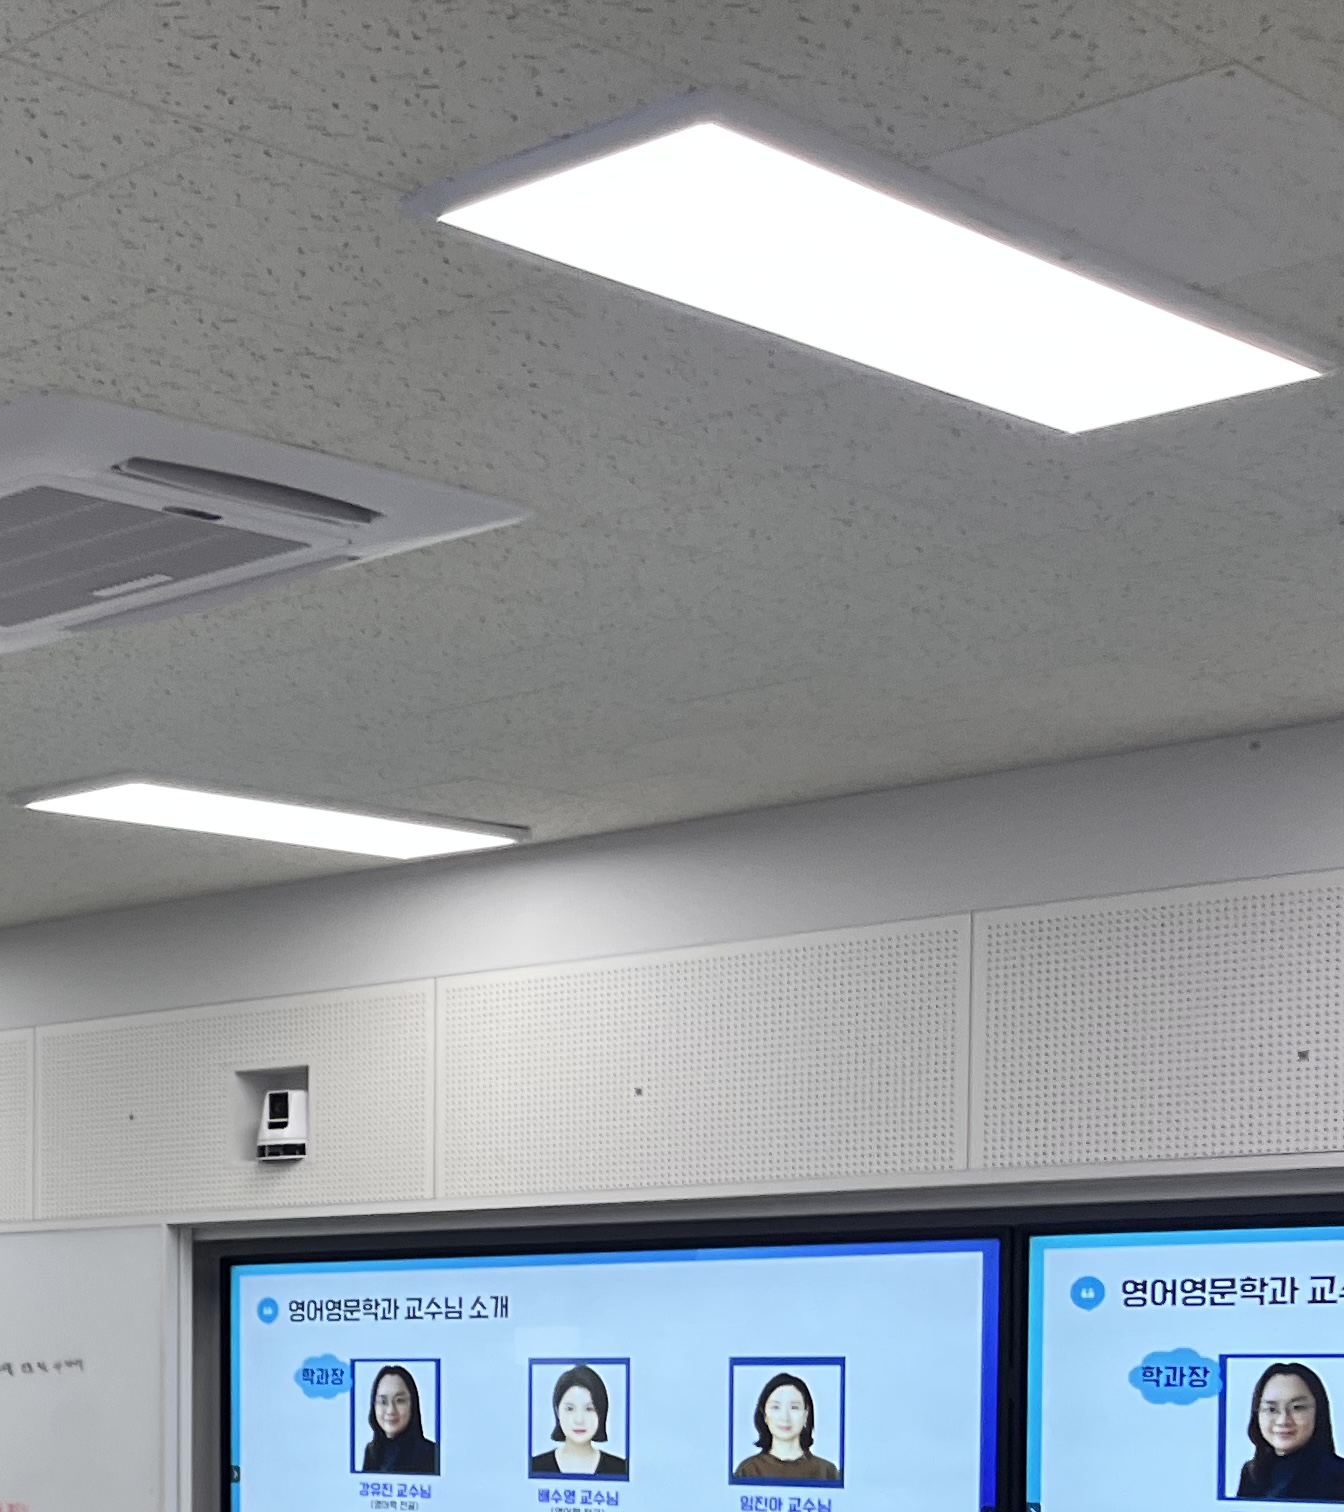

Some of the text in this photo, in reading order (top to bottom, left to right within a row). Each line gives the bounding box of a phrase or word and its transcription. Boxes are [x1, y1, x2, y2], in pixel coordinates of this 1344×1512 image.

[1122, 1276, 1344, 1308] 영어영문학과 교
[288, 1295, 509, 1322] 영어영문학과 교수님 소개
[302, 1367, 345, 1386] 학과장
[1142, 1365, 1210, 1388] 학과장
[359, 1482, 432, 1499] 강유진 교수님
[538, 1488, 619, 1506] 배수영 교수님
[740, 1495, 783, 1512] 임진아
